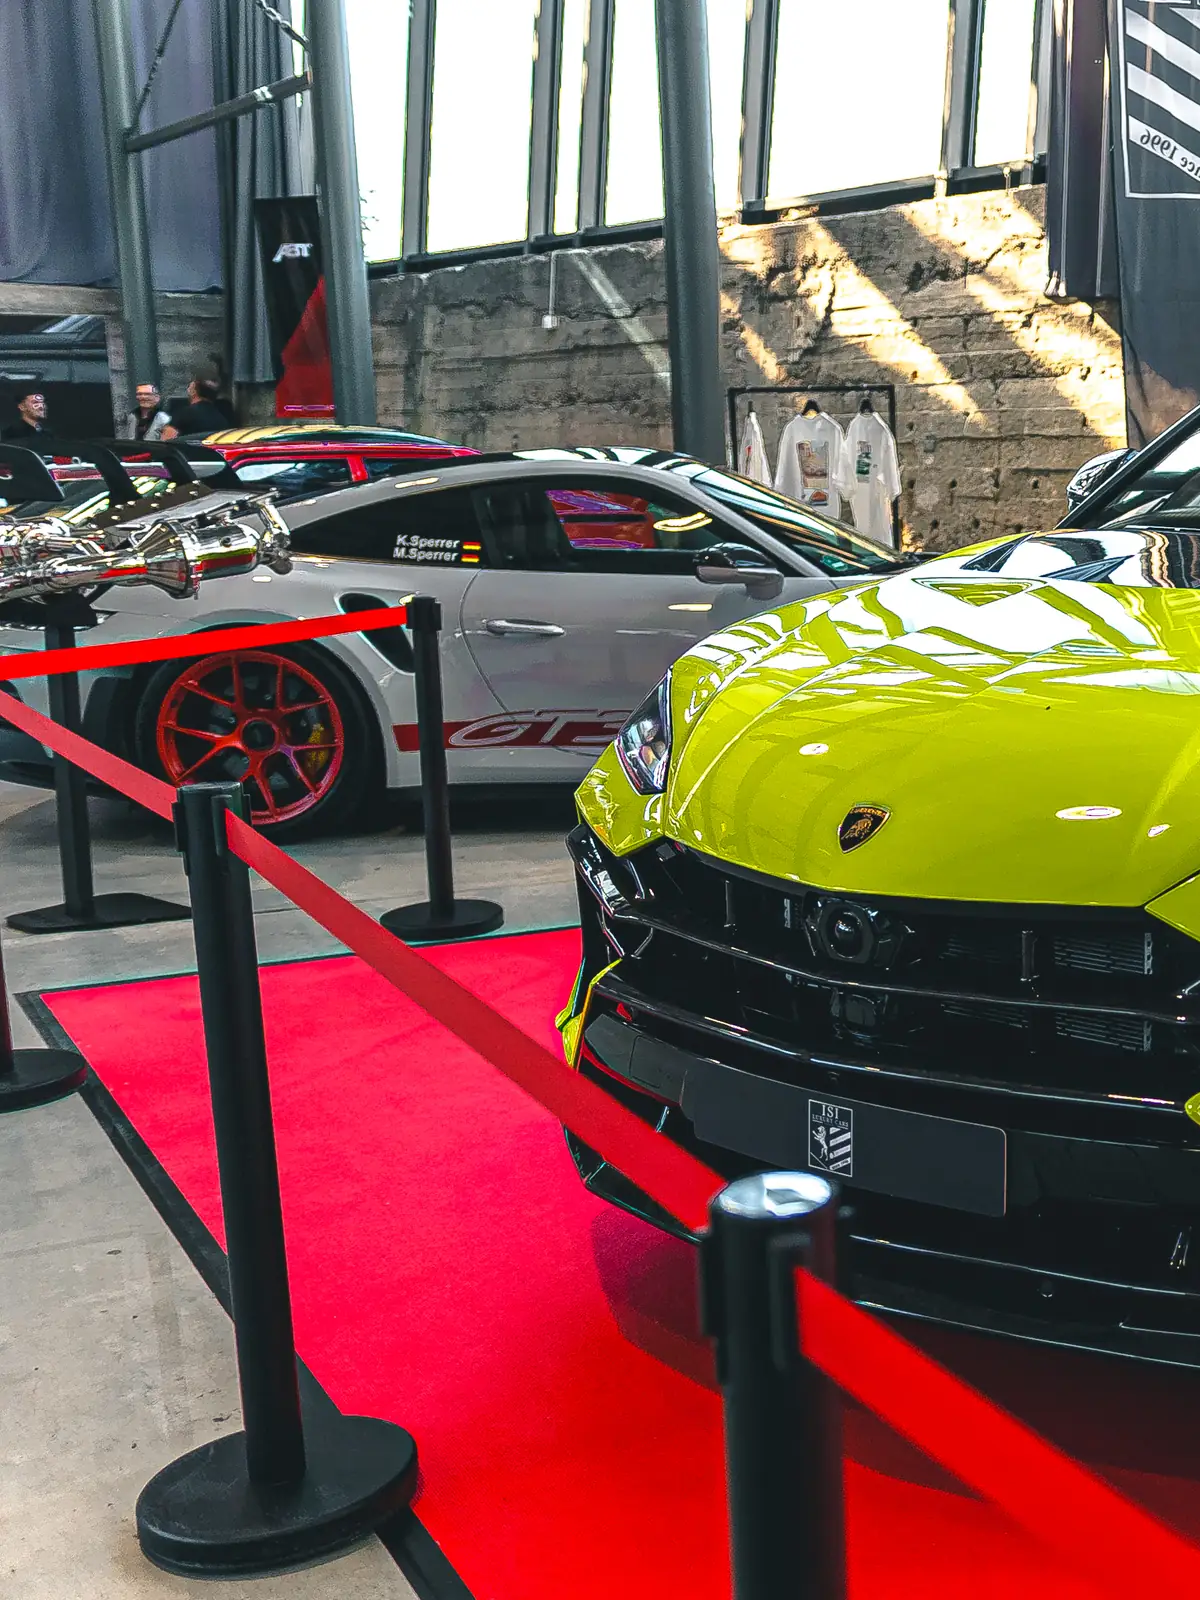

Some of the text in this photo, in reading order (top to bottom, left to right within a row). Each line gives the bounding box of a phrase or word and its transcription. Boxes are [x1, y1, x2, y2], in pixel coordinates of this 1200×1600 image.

[272, 243, 314, 262] ABT
[396, 534, 460, 549] K.Sperrer
[393, 547, 458, 561] M.Sperrer
[822, 1104, 839, 1119] ISI
